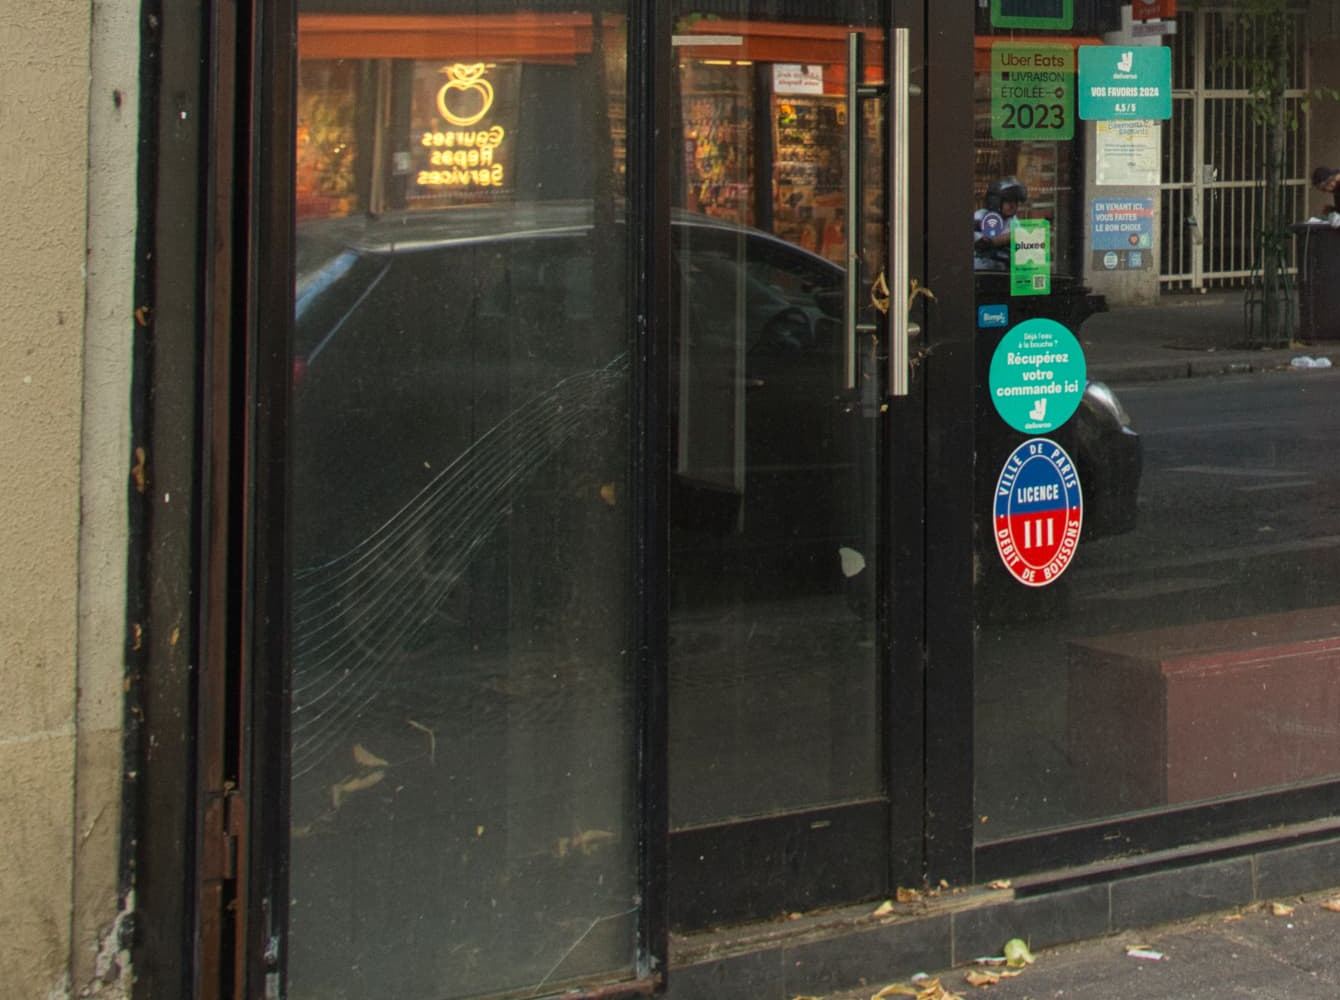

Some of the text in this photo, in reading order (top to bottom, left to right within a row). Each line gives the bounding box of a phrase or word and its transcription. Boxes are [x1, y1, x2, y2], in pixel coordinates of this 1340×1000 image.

[1001, 52, 1065, 67] Uber Eats
[1011, 71, 1065, 82] LIVRAISON
[1001, 84, 1045, 98] ÉTOILÉE
[1090, 87, 1159, 97] VOS FAVORIS 2024
[1001, 103, 1065, 130] 2023
[1095, 202, 1105, 211] EN
[1106, 202, 1134, 211] VENANT
[1095, 213, 1137, 222] VOUS FAITES
[1095, 223, 1104, 232] LE
[1104, 223, 1120, 232] BON
[1015, 240, 1046, 252] pluxee
[1007, 350, 1069, 368] Récupérez
[1022, 369, 1054, 381] votre
[996, 379, 1079, 397] commande ici
[998, 442, 1077, 496] VILLE DE PARIS
[1017, 483, 1059, 504] LICENCE
[1024, 517, 1054, 549] III
[998, 520, 1079, 582] DEBIT DE BOISSONS
